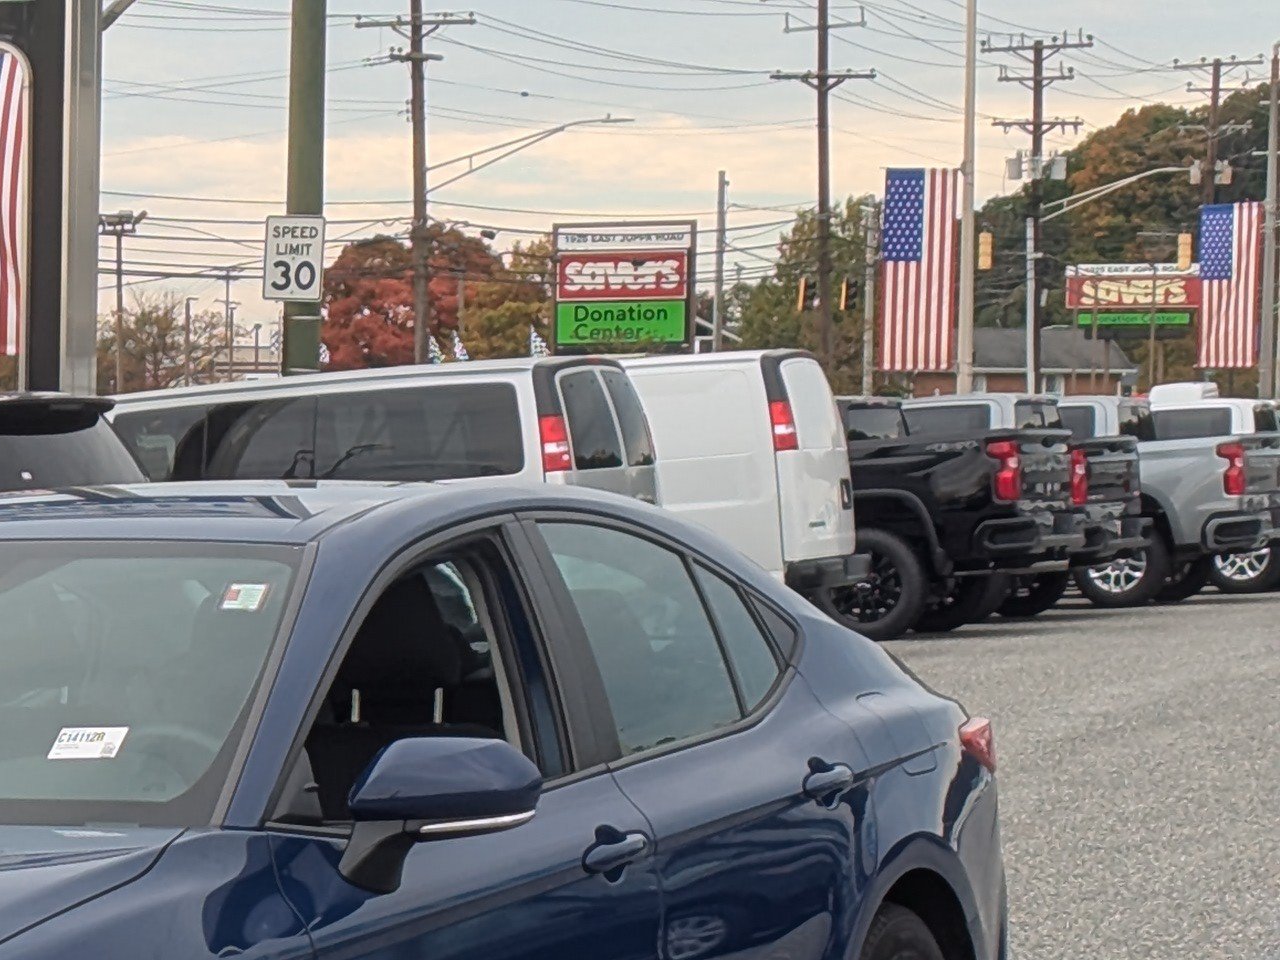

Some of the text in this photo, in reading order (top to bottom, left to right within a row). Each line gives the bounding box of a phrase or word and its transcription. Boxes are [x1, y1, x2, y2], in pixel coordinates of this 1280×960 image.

[273, 225, 319, 239] SPEED
[591, 233, 616, 243] EAST
[620, 232, 652, 242] JOPPA
[656, 231, 684, 241] ROAD
[276, 243, 312, 256] LIMIT
[271, 260, 316, 291] 30
[1107, 265, 1130, 273] EAST
[574, 304, 668, 322] Donation
[1094, 313, 1138, 323] onation
[574, 323, 644, 341] Center
